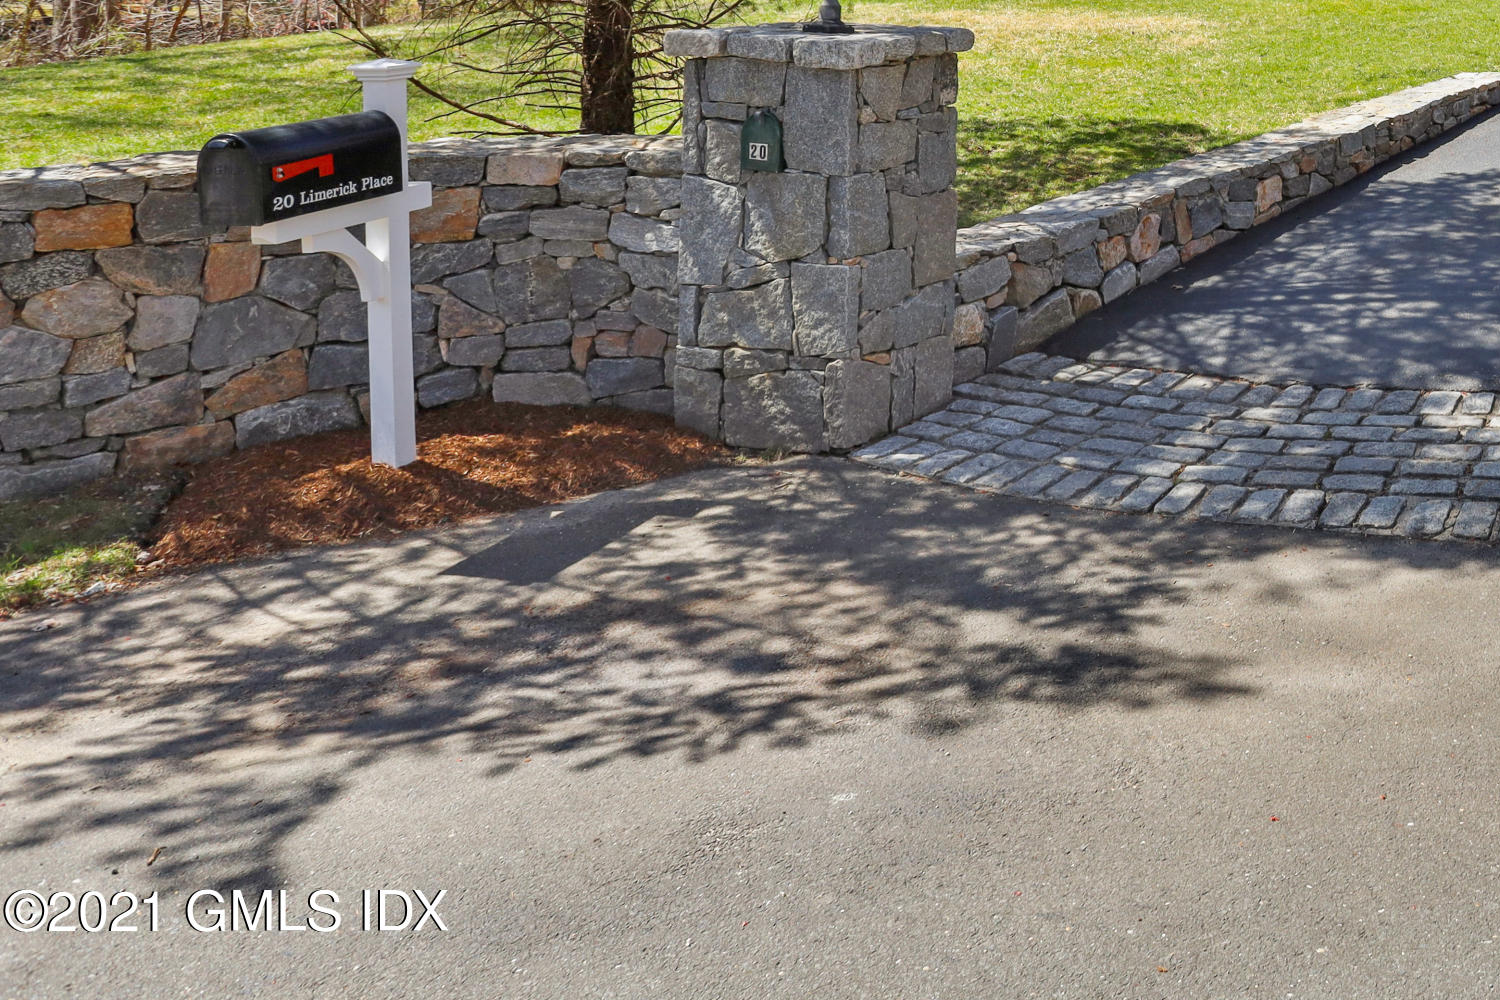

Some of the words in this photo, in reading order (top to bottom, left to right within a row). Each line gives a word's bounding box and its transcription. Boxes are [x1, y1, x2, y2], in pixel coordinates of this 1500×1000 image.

[751, 145, 766, 159] 20
[273, 195, 294, 211] 20
[300, 181, 357, 205] Limerick
[362, 174, 393, 191] Place
